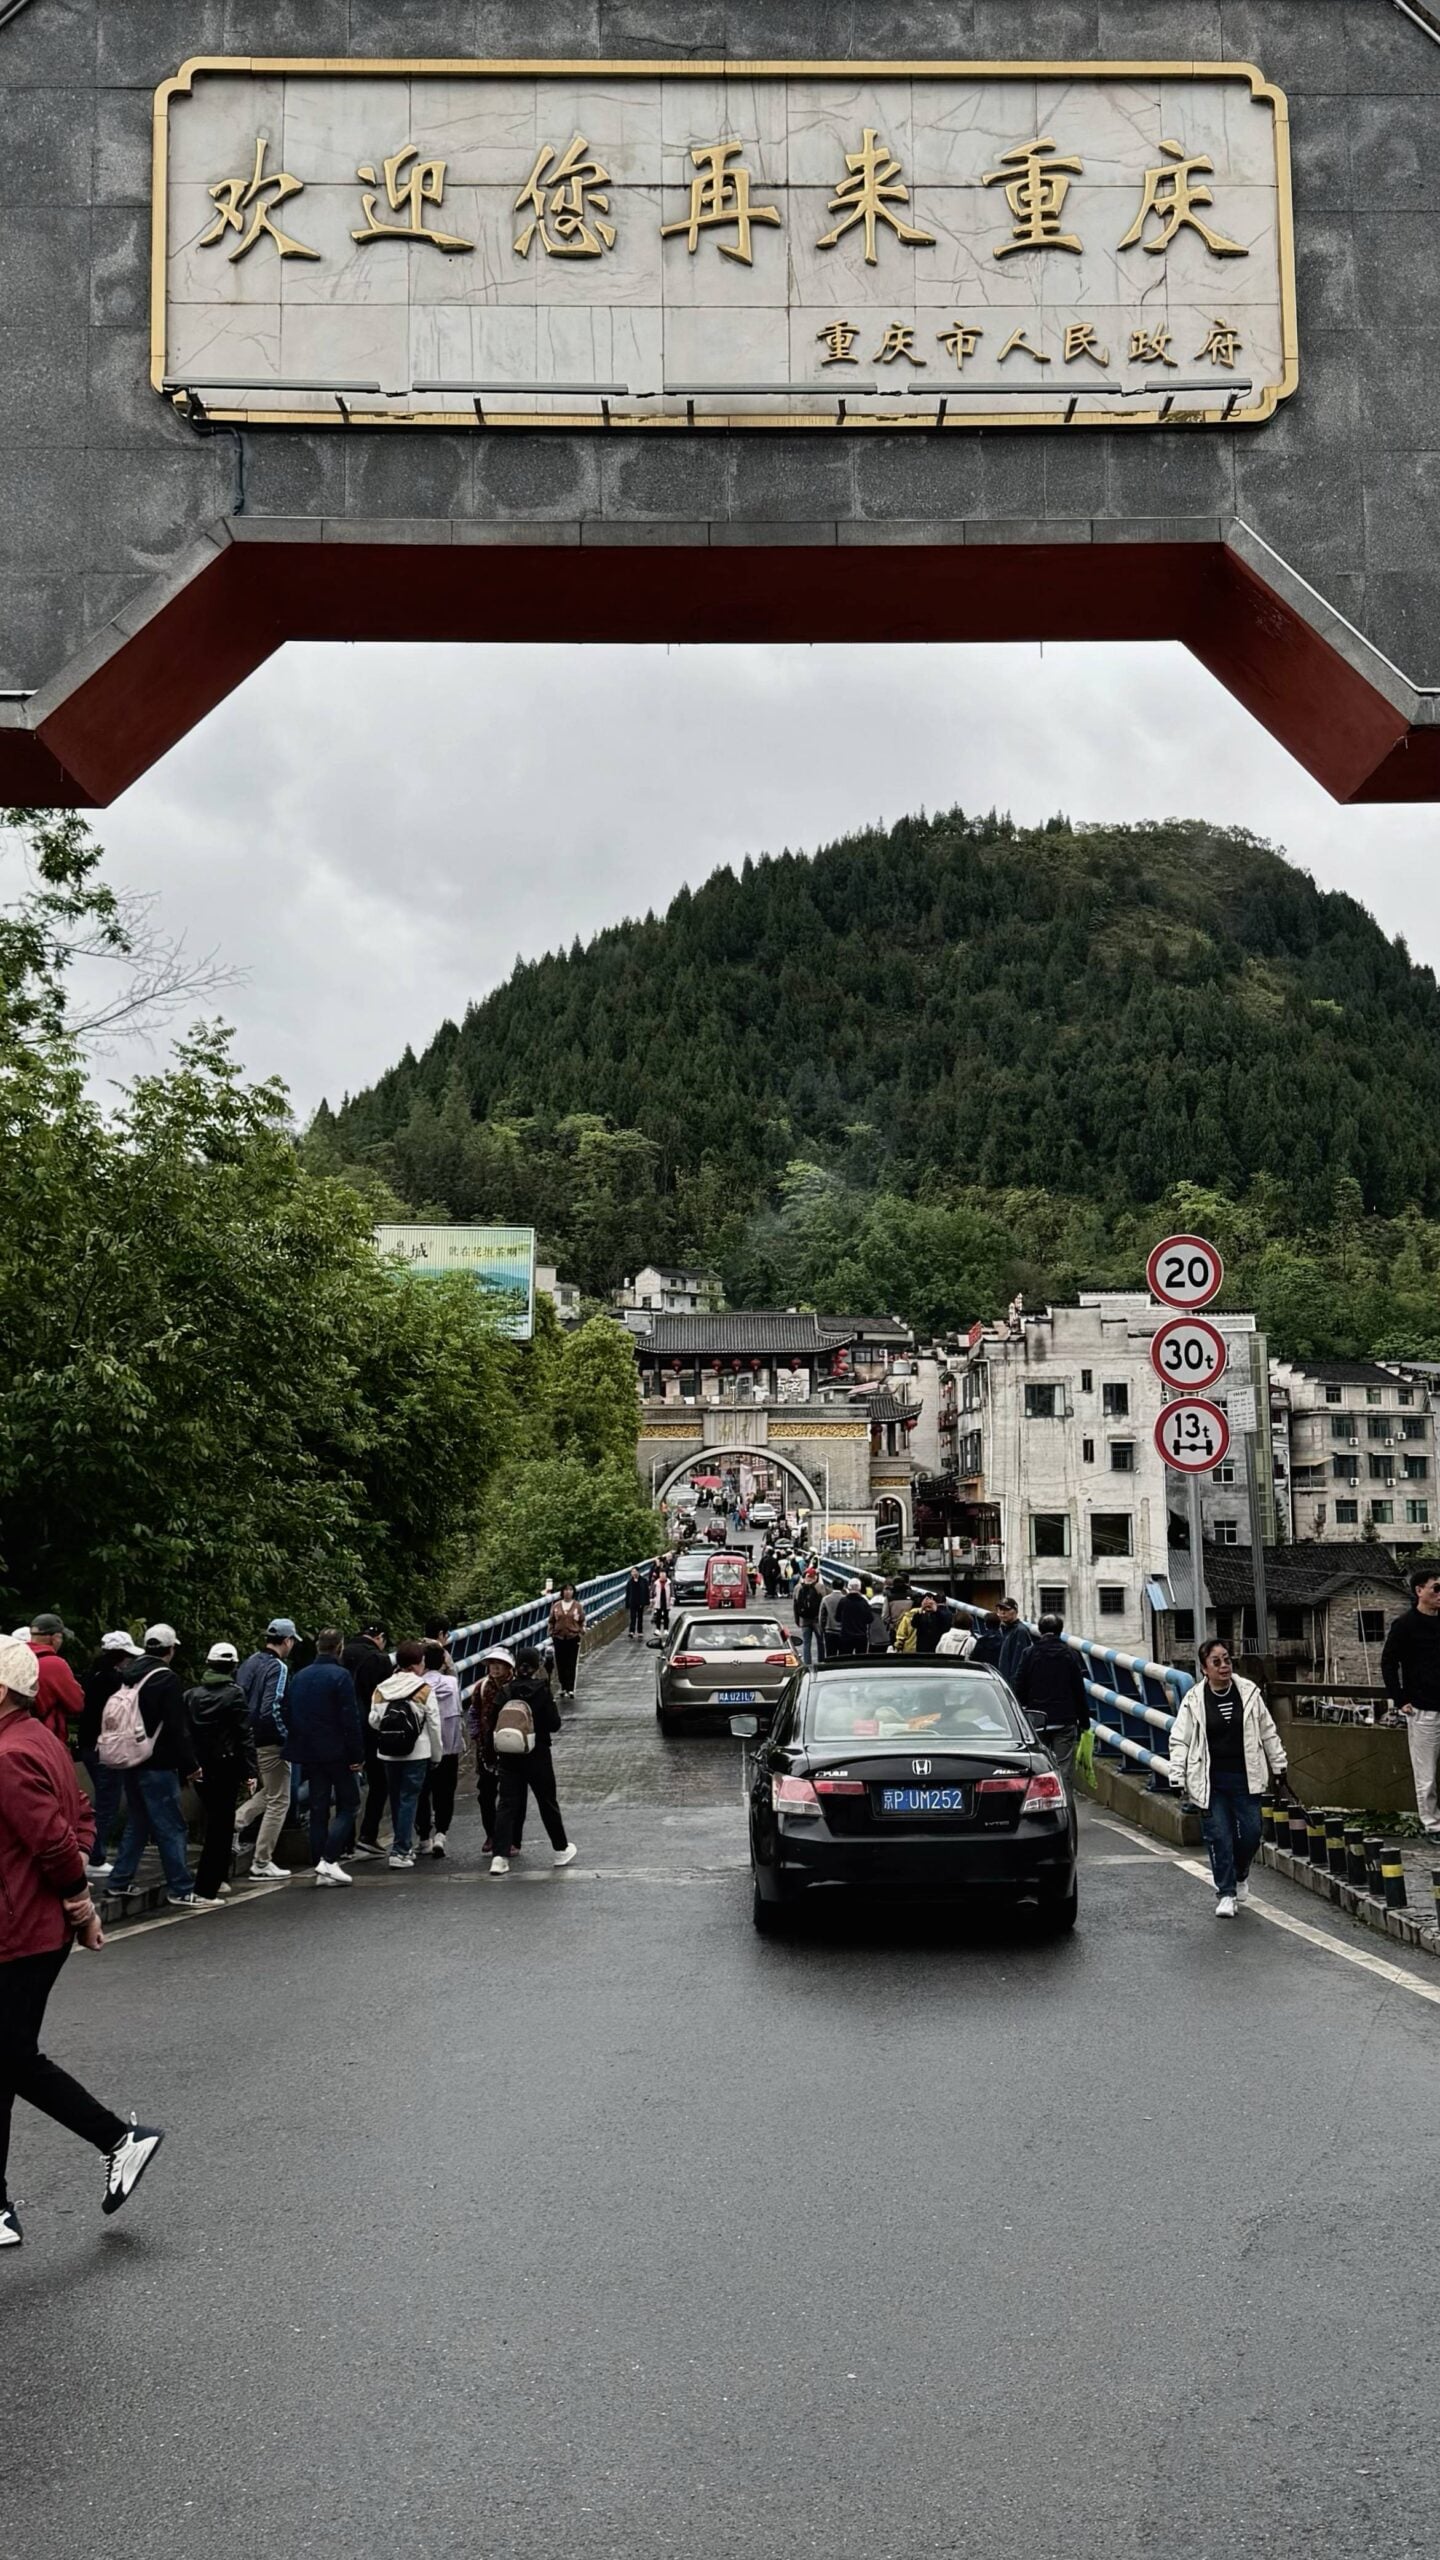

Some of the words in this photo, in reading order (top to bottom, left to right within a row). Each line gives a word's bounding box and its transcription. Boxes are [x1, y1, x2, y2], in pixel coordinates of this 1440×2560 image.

[199, 128, 1250, 267] 欢迎您再来重庆
[815, 319, 1244, 370] 重庆市人民政府
[1164, 1257, 1209, 1288] 20
[1164, 1338, 1214, 1370] 30t
[1175, 1412, 1210, 1439] 13t
